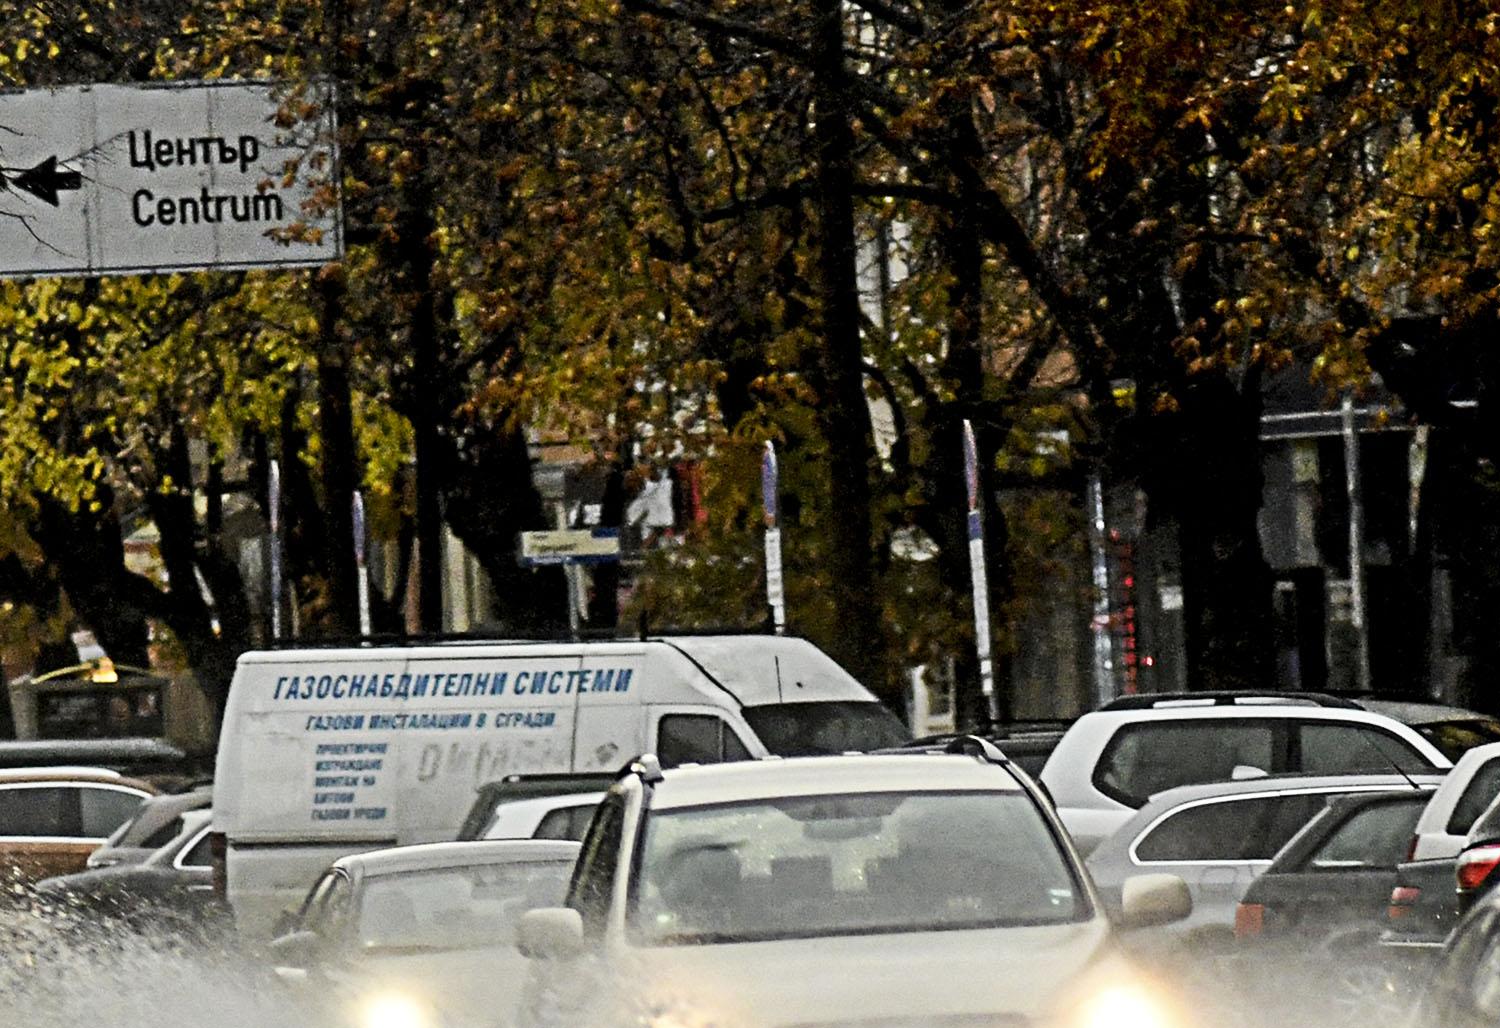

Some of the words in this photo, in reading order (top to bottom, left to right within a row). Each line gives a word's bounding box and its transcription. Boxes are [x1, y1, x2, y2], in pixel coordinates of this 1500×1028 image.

[128, 129, 259, 173] Център
[132, 187, 283, 226] Centrum
[273, 672, 507, 700] ГАЗОСНАБДИТЕЛНИ
[513, 669, 633, 695] СИСТЕМИ
[305, 714, 364, 731] ГАЗОВИ
[368, 713, 472, 730] ИНСТАЛАЦИИ
[495, 712, 556, 729] СГРАДИ
